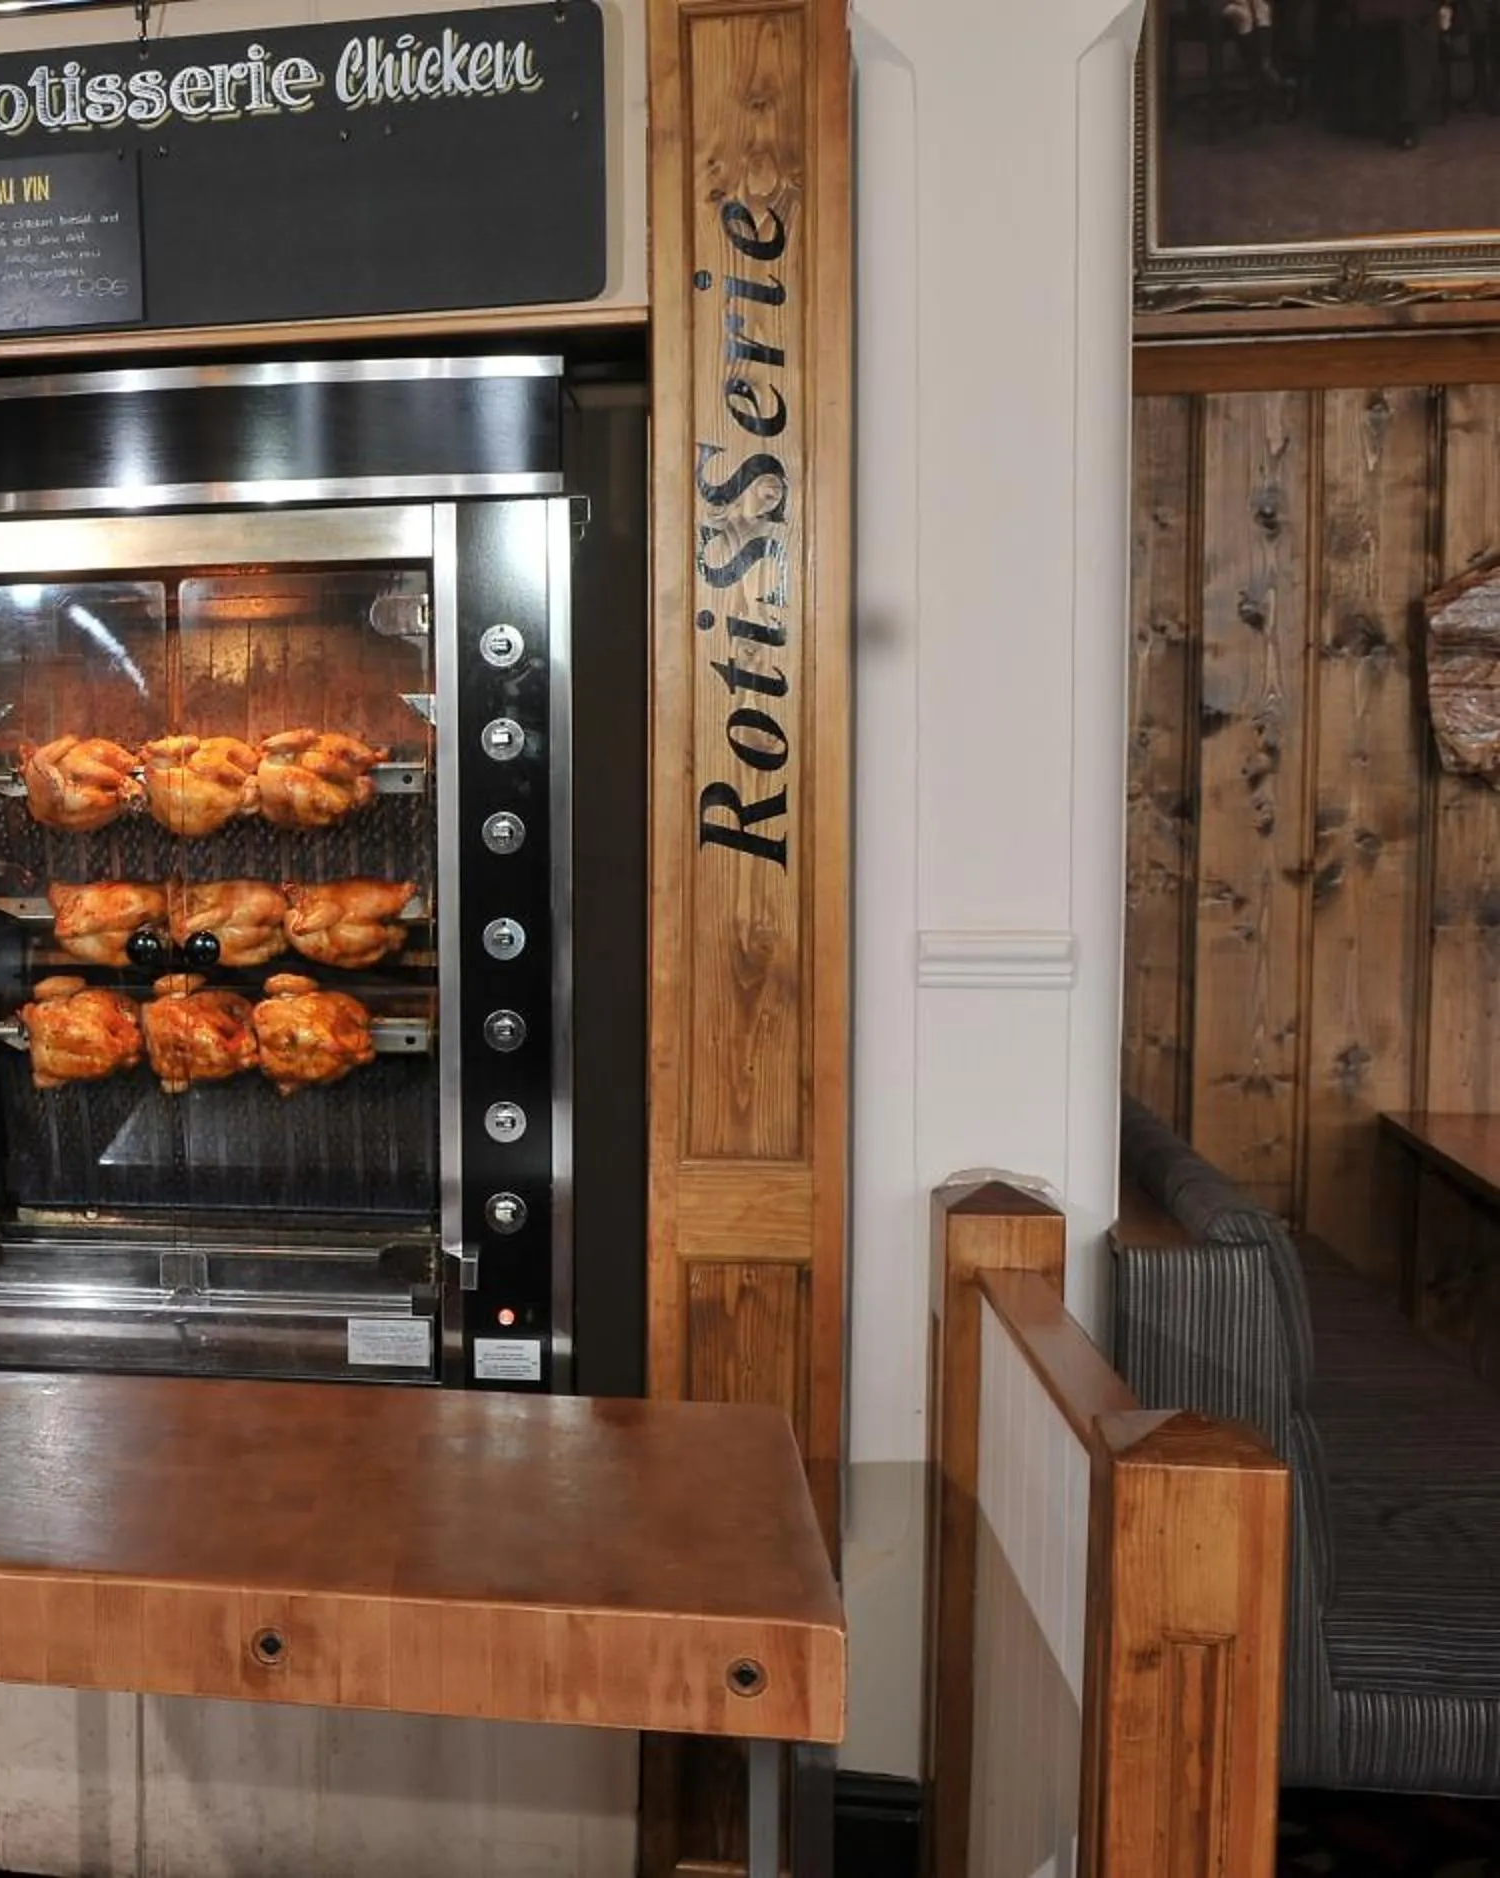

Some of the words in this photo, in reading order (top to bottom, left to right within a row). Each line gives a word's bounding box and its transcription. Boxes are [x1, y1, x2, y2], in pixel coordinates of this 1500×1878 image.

[335, 28, 543, 109] Chicken
[23, 175, 49, 202] VIN
[100, 211, 120, 223] and
[12, 233, 31, 246] red
[66, 231, 86, 243] and
